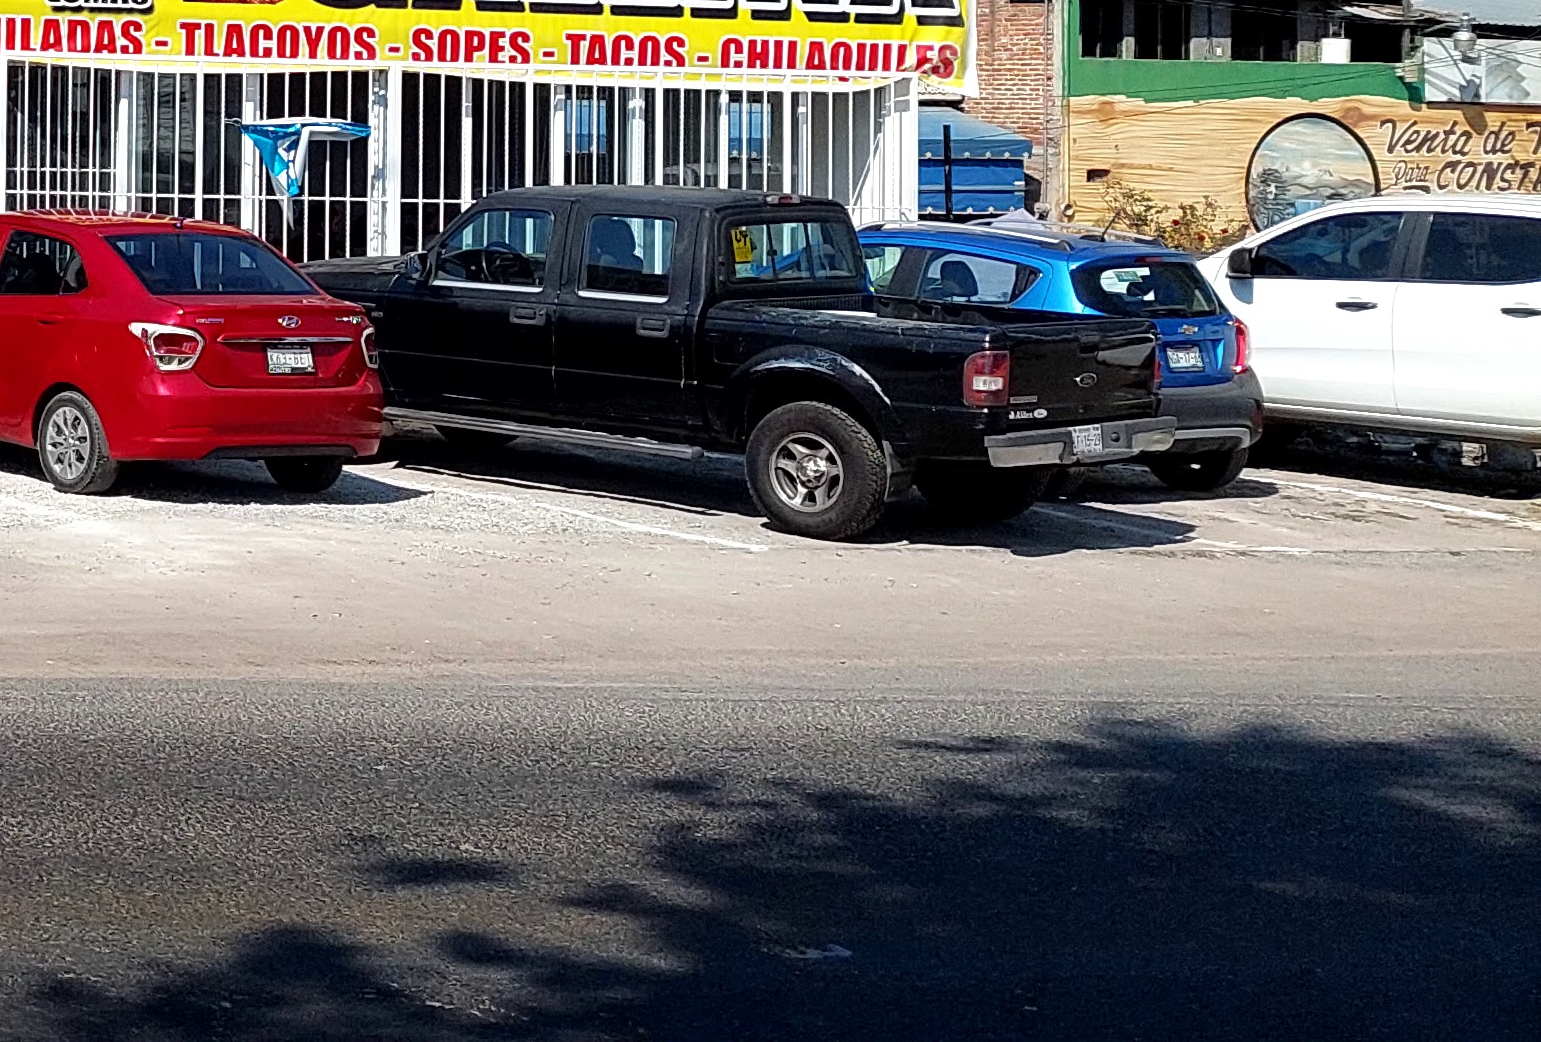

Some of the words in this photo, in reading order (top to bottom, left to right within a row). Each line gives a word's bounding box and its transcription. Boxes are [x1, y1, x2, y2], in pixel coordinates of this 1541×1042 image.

[179, 21, 377, 60] TLACOYOS
[411, 27, 532, 64] SOPES
[564, 32, 688, 67] TACOS
[720, 37, 960, 81] CHILAQUILES
[1379, 119, 1474, 157] Venta
[1483, 121, 1517, 156] de
[1392, 160, 1430, 186] Para
